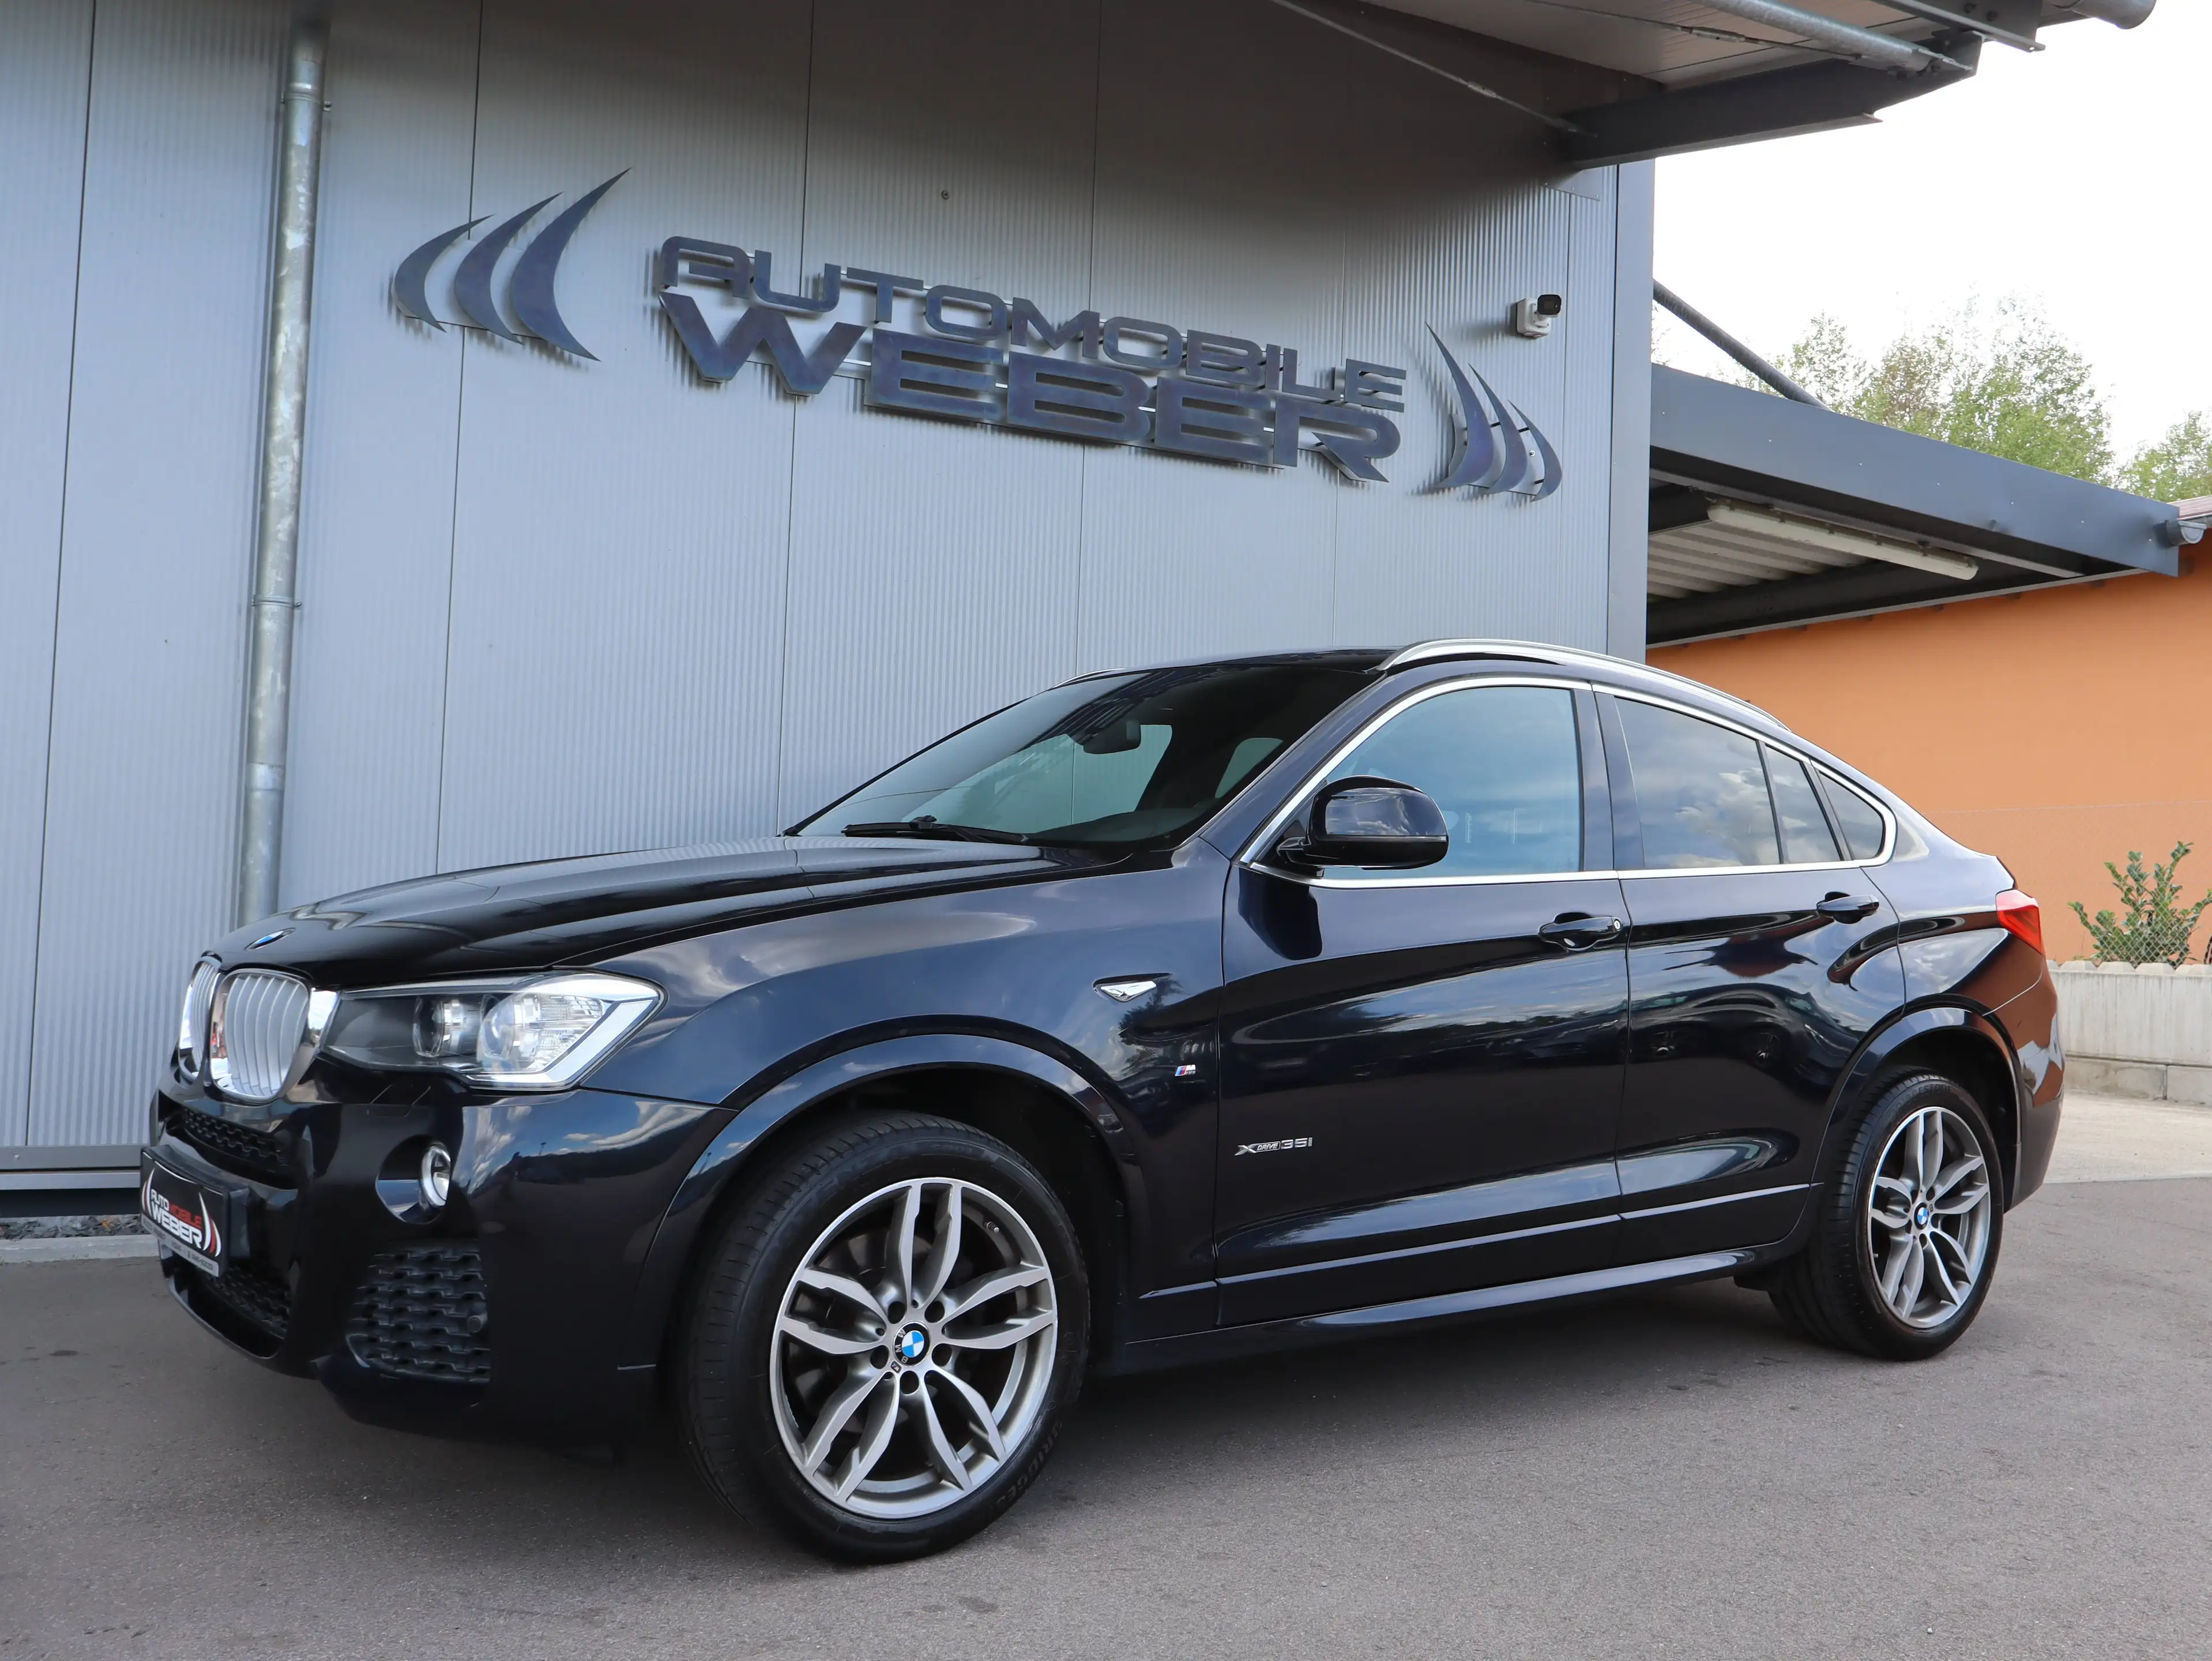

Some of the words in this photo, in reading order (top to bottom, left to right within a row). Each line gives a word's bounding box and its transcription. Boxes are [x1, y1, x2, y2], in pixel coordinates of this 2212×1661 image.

[661, 236, 1406, 412] AUTOMOBILE
[659, 291, 1402, 483] WEBER
[151, 1201, 202, 1249] WEBER
[894, 1328, 909, 1364] BMW
